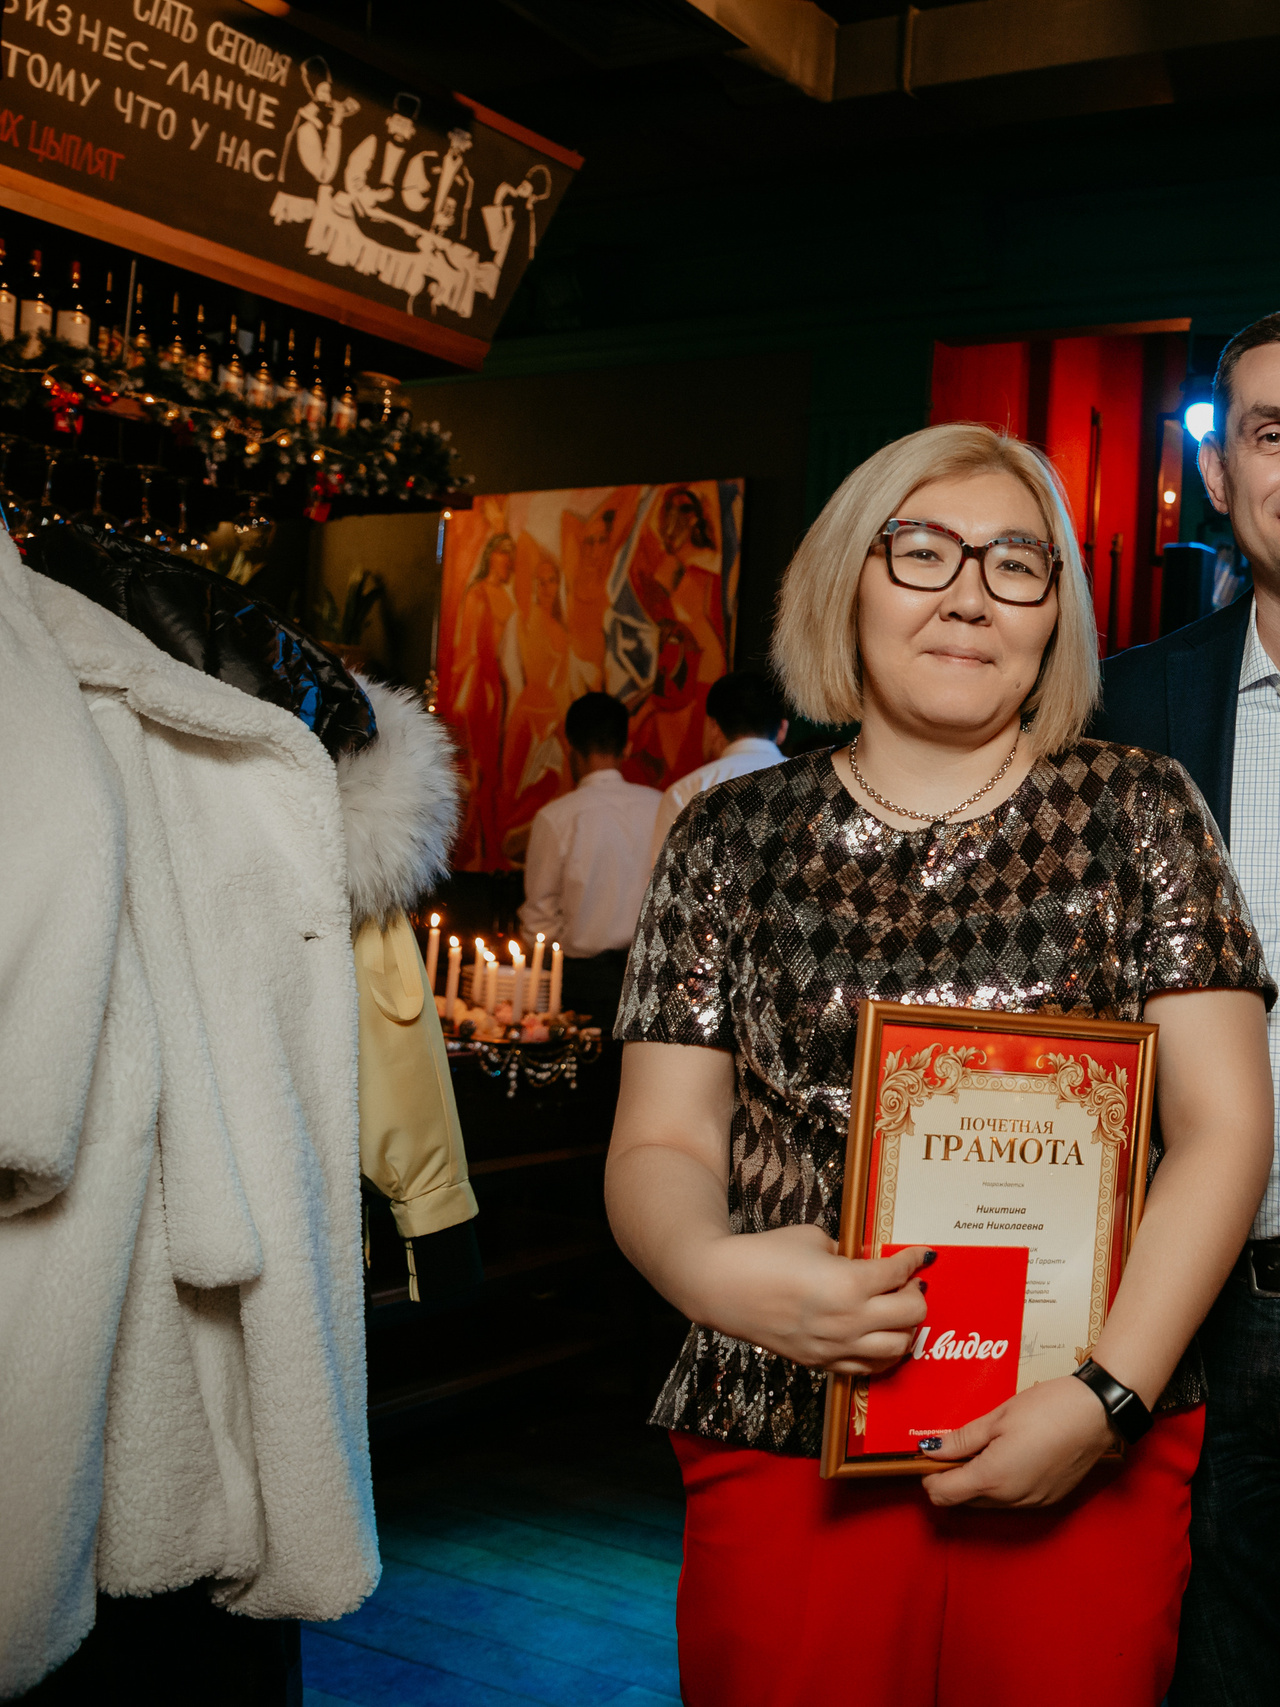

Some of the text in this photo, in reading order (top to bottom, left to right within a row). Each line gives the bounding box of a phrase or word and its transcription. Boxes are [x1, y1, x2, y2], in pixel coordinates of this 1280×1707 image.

[1, 40, 277, 182] ТОМУ ЧТО У НАС
[28, 120, 125, 182] ЦЫПЛЯТ
[960, 1117, 1054, 1134] ПОЧЕТНАЯ
[922, 1134, 1084, 1165] ГРАМОТА
[976, 1204, 1026, 1215] Никитина
[953, 1220, 1044, 1231] Алена Николаевна
